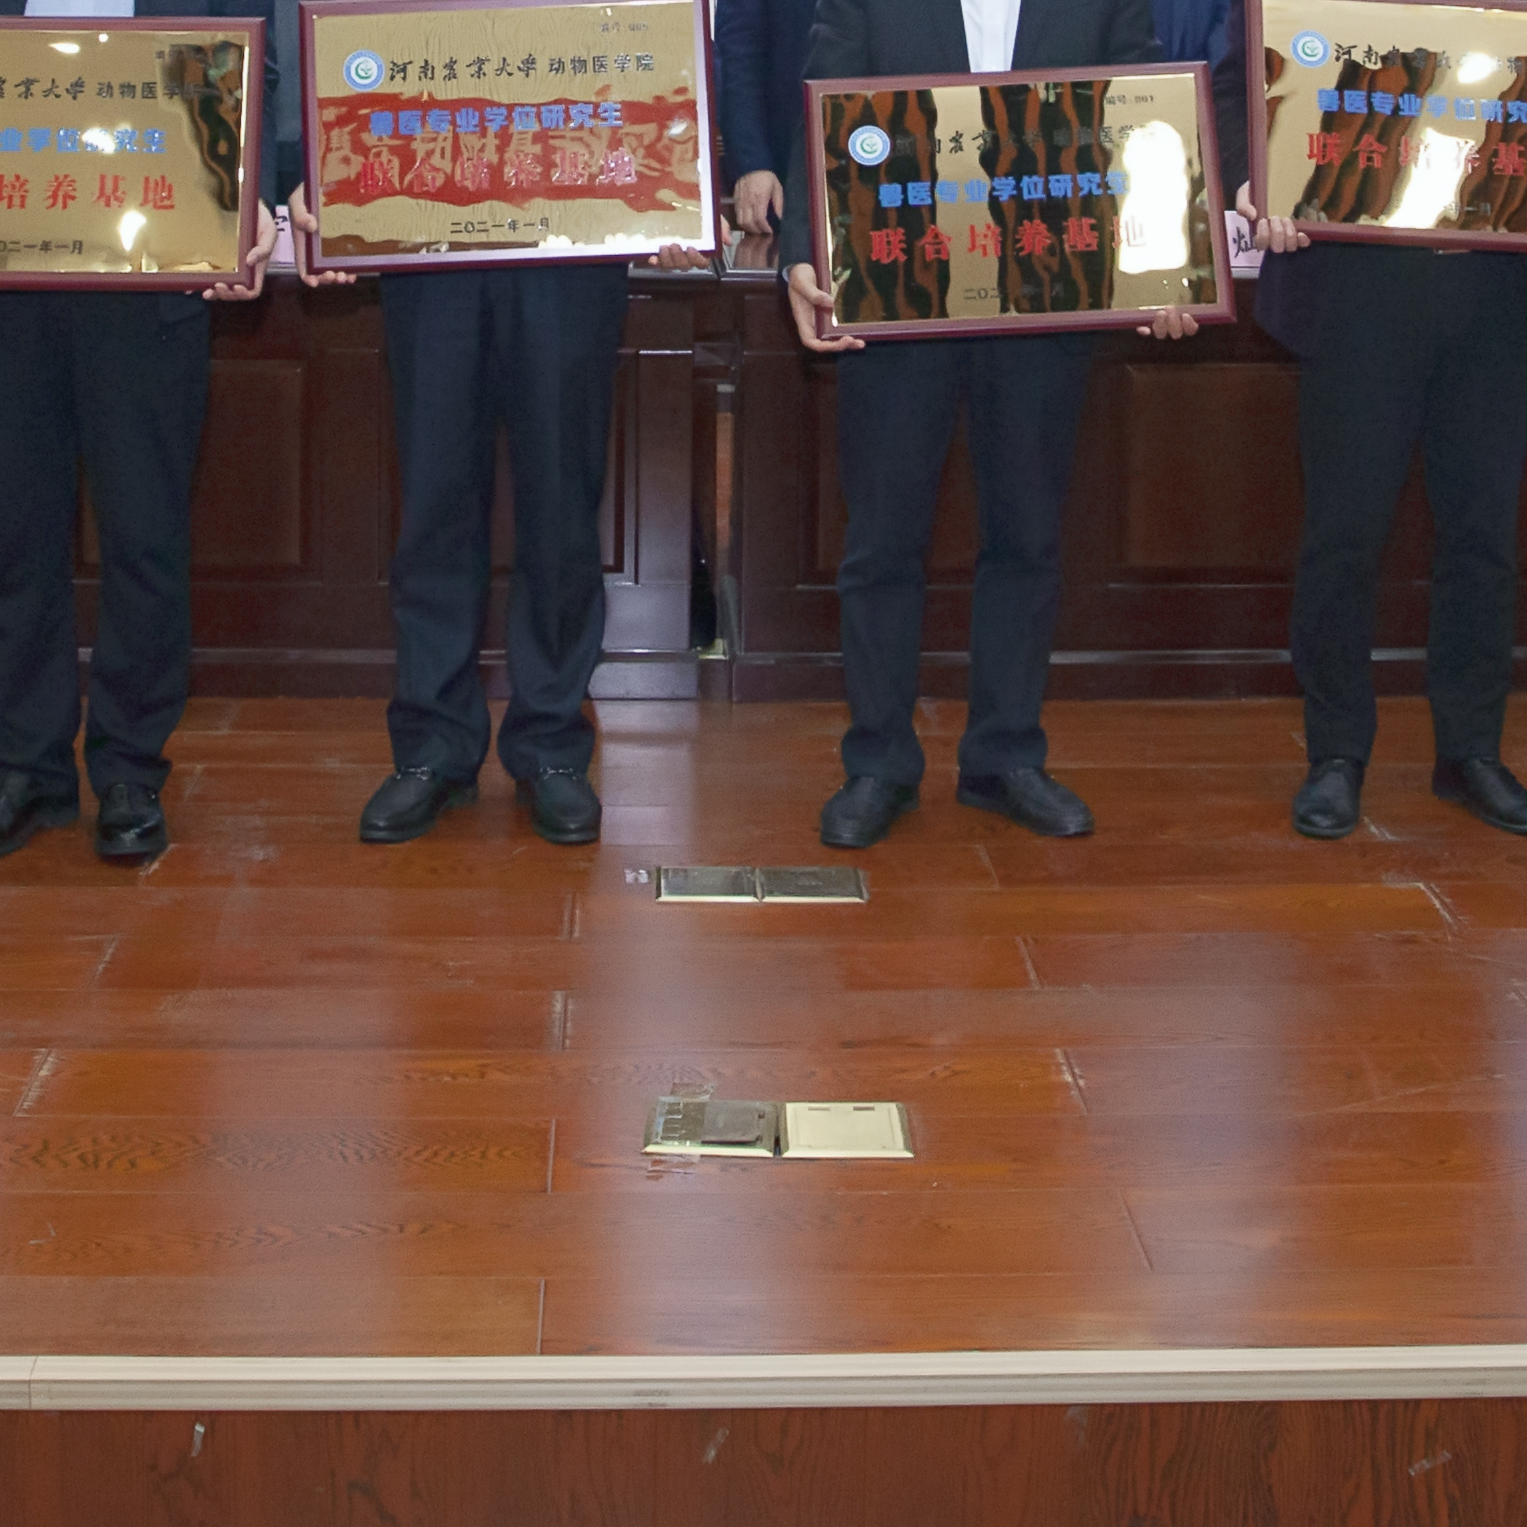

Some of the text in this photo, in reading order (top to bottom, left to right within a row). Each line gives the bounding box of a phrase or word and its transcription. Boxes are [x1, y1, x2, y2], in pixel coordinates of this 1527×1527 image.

[370, 102, 623, 136] 兽医专业学位研究生
[878, 170, 1133, 209] 兽医专业学位研究生
[868, 216, 1148, 264] 联合培养基地
